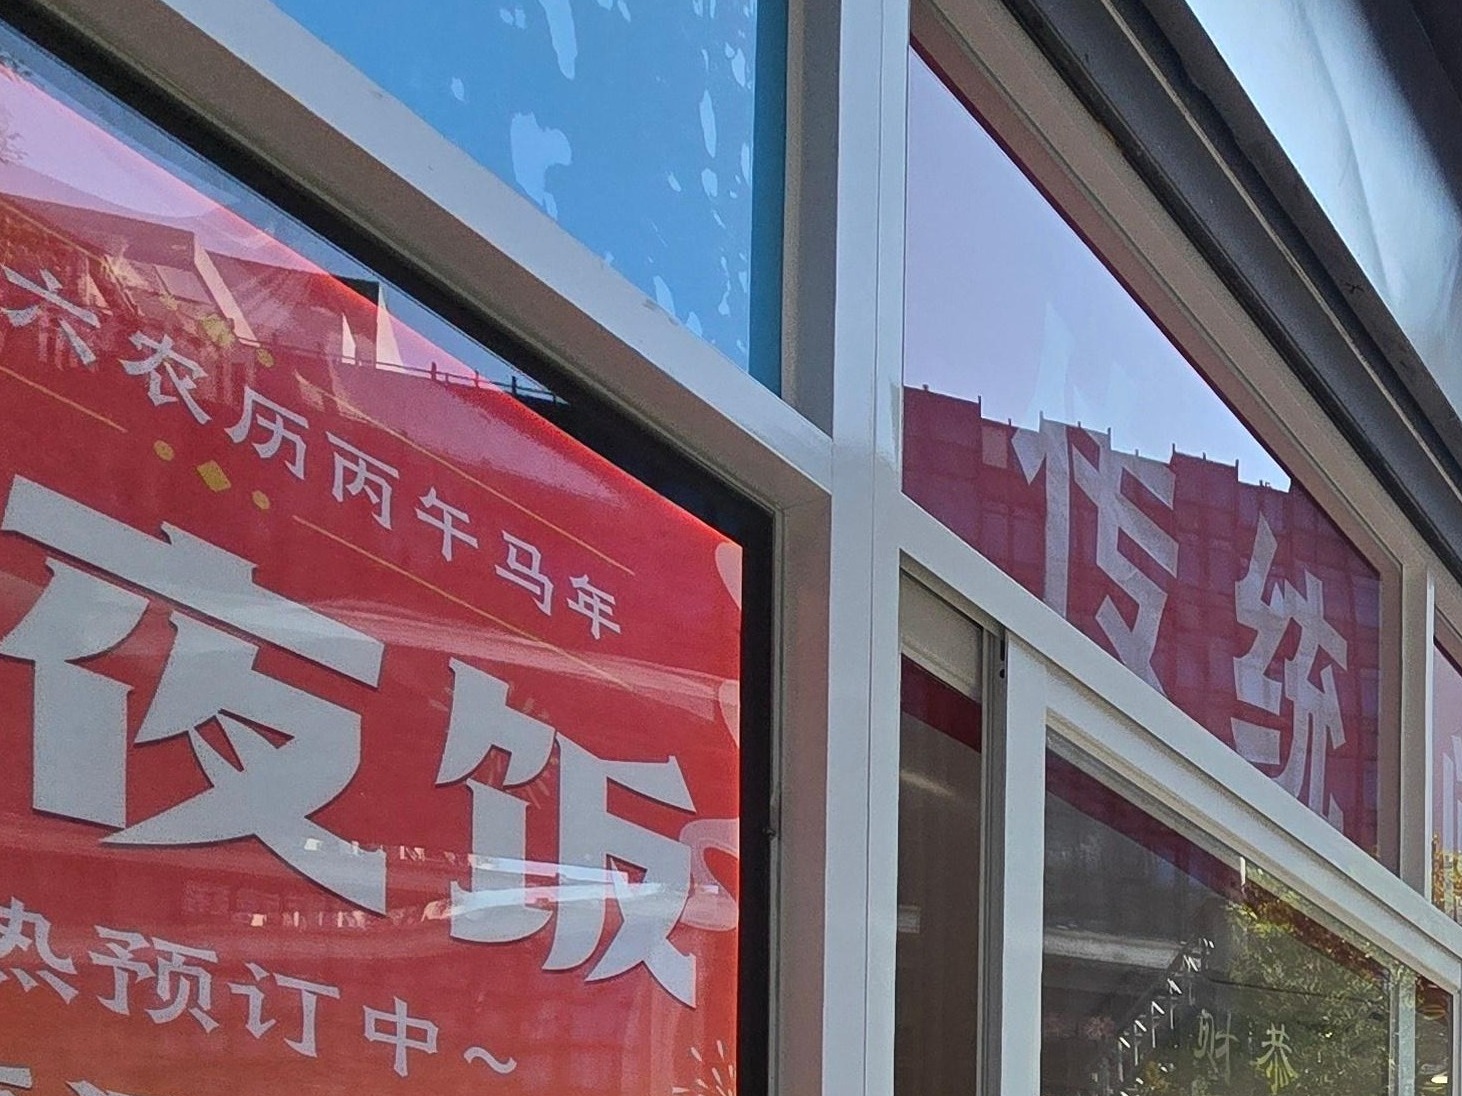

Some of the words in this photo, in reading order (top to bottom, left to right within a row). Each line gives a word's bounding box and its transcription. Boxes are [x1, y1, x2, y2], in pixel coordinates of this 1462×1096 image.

[0, 263, 622, 640] 六农历丙午马年
[2, 476, 697, 1008] 夜饭
